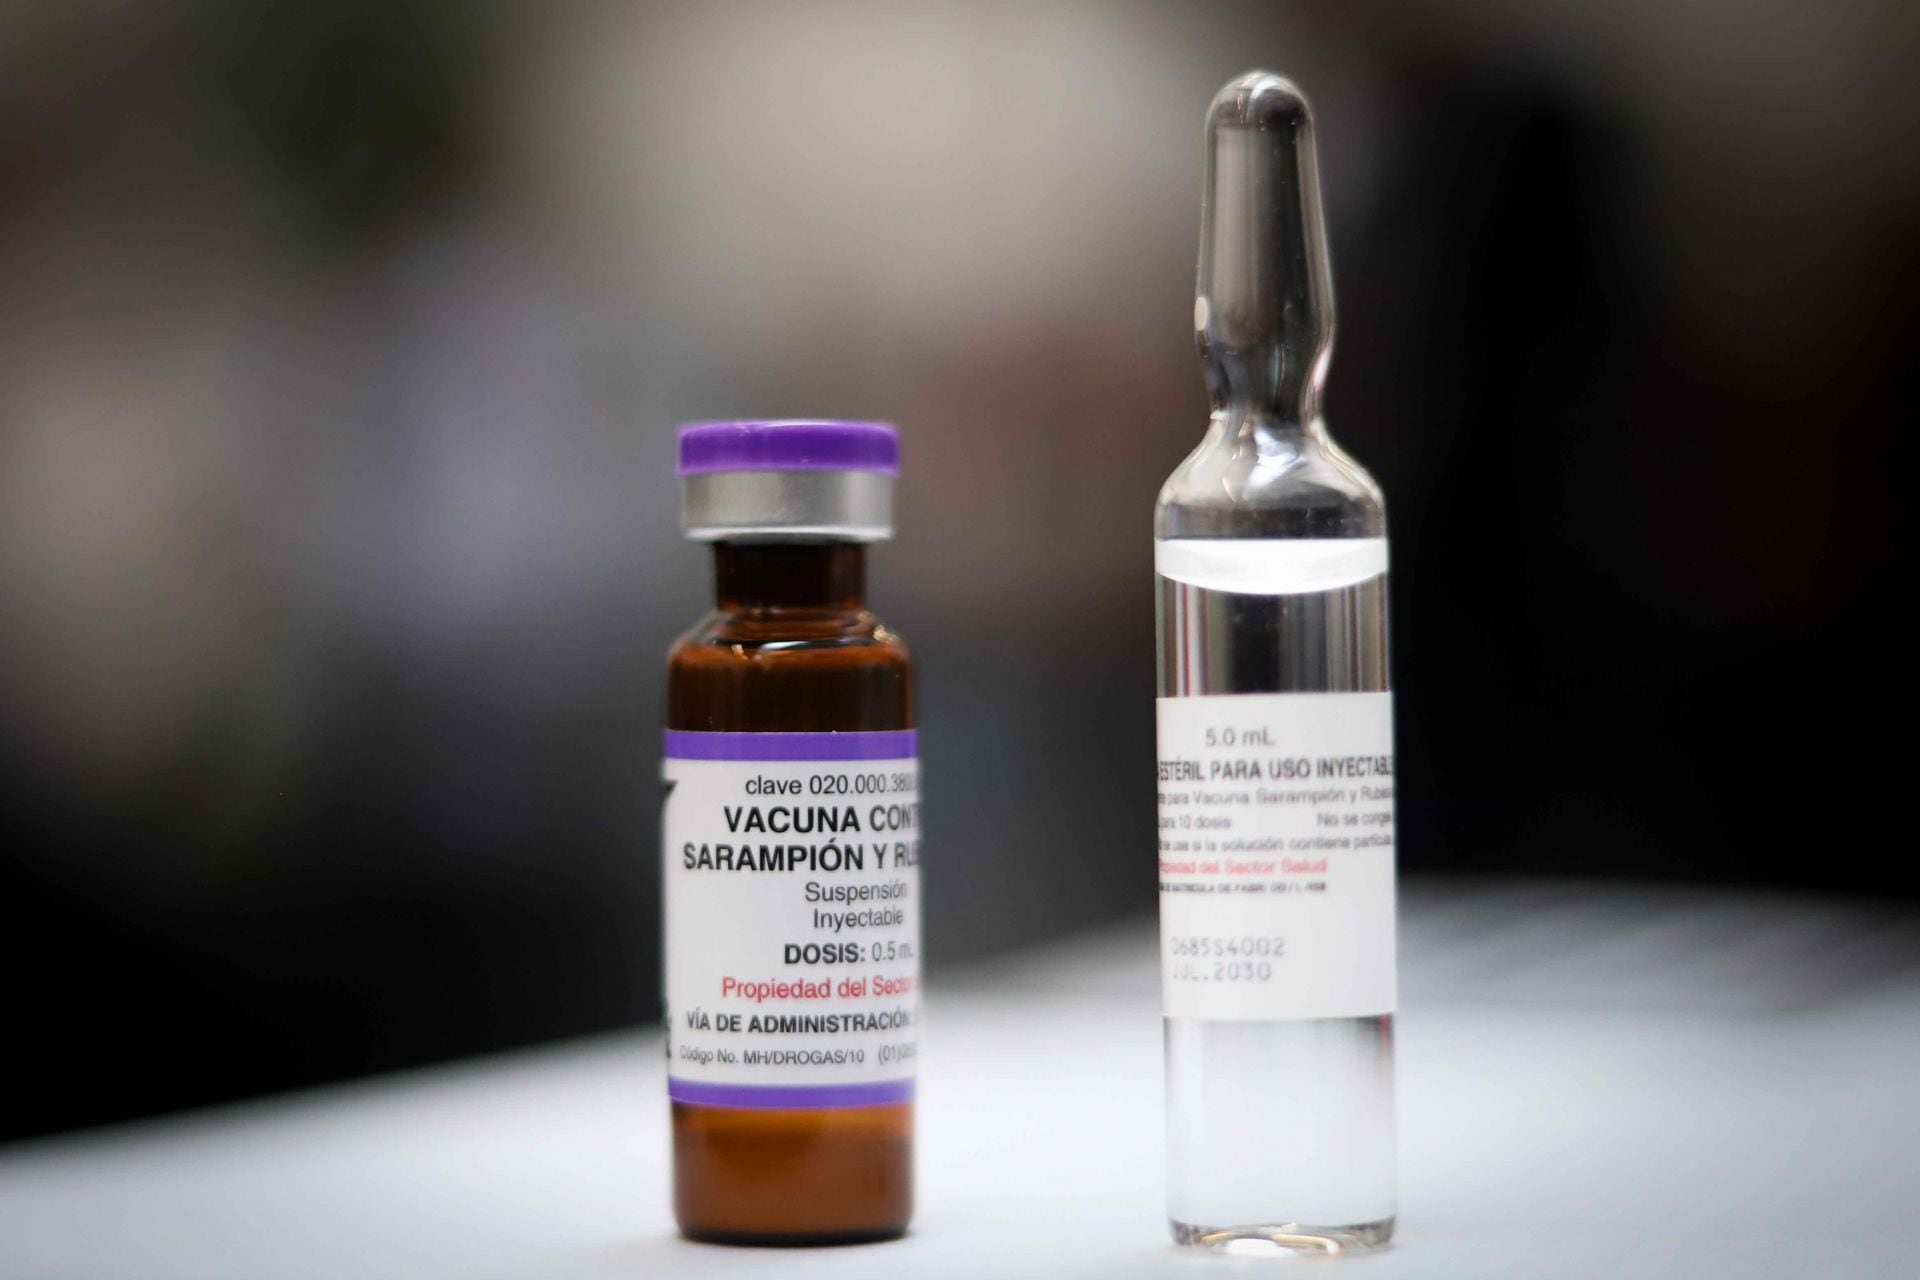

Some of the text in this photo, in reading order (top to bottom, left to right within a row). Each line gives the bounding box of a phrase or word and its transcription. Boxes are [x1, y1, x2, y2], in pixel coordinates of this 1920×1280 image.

[1206, 728, 1236, 747] 5.0
[1210, 760, 1262, 781] PARA
[1268, 758, 1311, 780] USO
[745, 775, 802, 795] clave
[1192, 790, 1250, 806] Vacuna
[1256, 787, 1345, 807] Sarampión
[1350, 789, 1358, 806] y
[724, 806, 861, 833] VACUNA
[1195, 814, 1232, 830] dosis
[1317, 811, 1339, 828] No
[683, 837, 863, 872] SARAMPIÓN
[872, 843, 888, 870] Y
[1221, 836, 1285, 852] solución
[1288, 836, 1350, 851] contiene
[1225, 858, 1275, 875] Sector
[1281, 857, 1328, 874] Salud
[804, 879, 907, 905] Suspensión
[813, 905, 904, 933] Inyectable
[784, 943, 866, 965] DOSIS:
[872, 940, 896, 963] 0.5
[722, 975, 831, 1003] Propiedad
[837, 977, 866, 998] del
[687, 1007, 711, 1031] VÍA
[716, 1013, 742, 1033] DE
[717, 1048, 739, 1064] No.
[744, 1048, 865, 1066] MH/DROGAS/10
